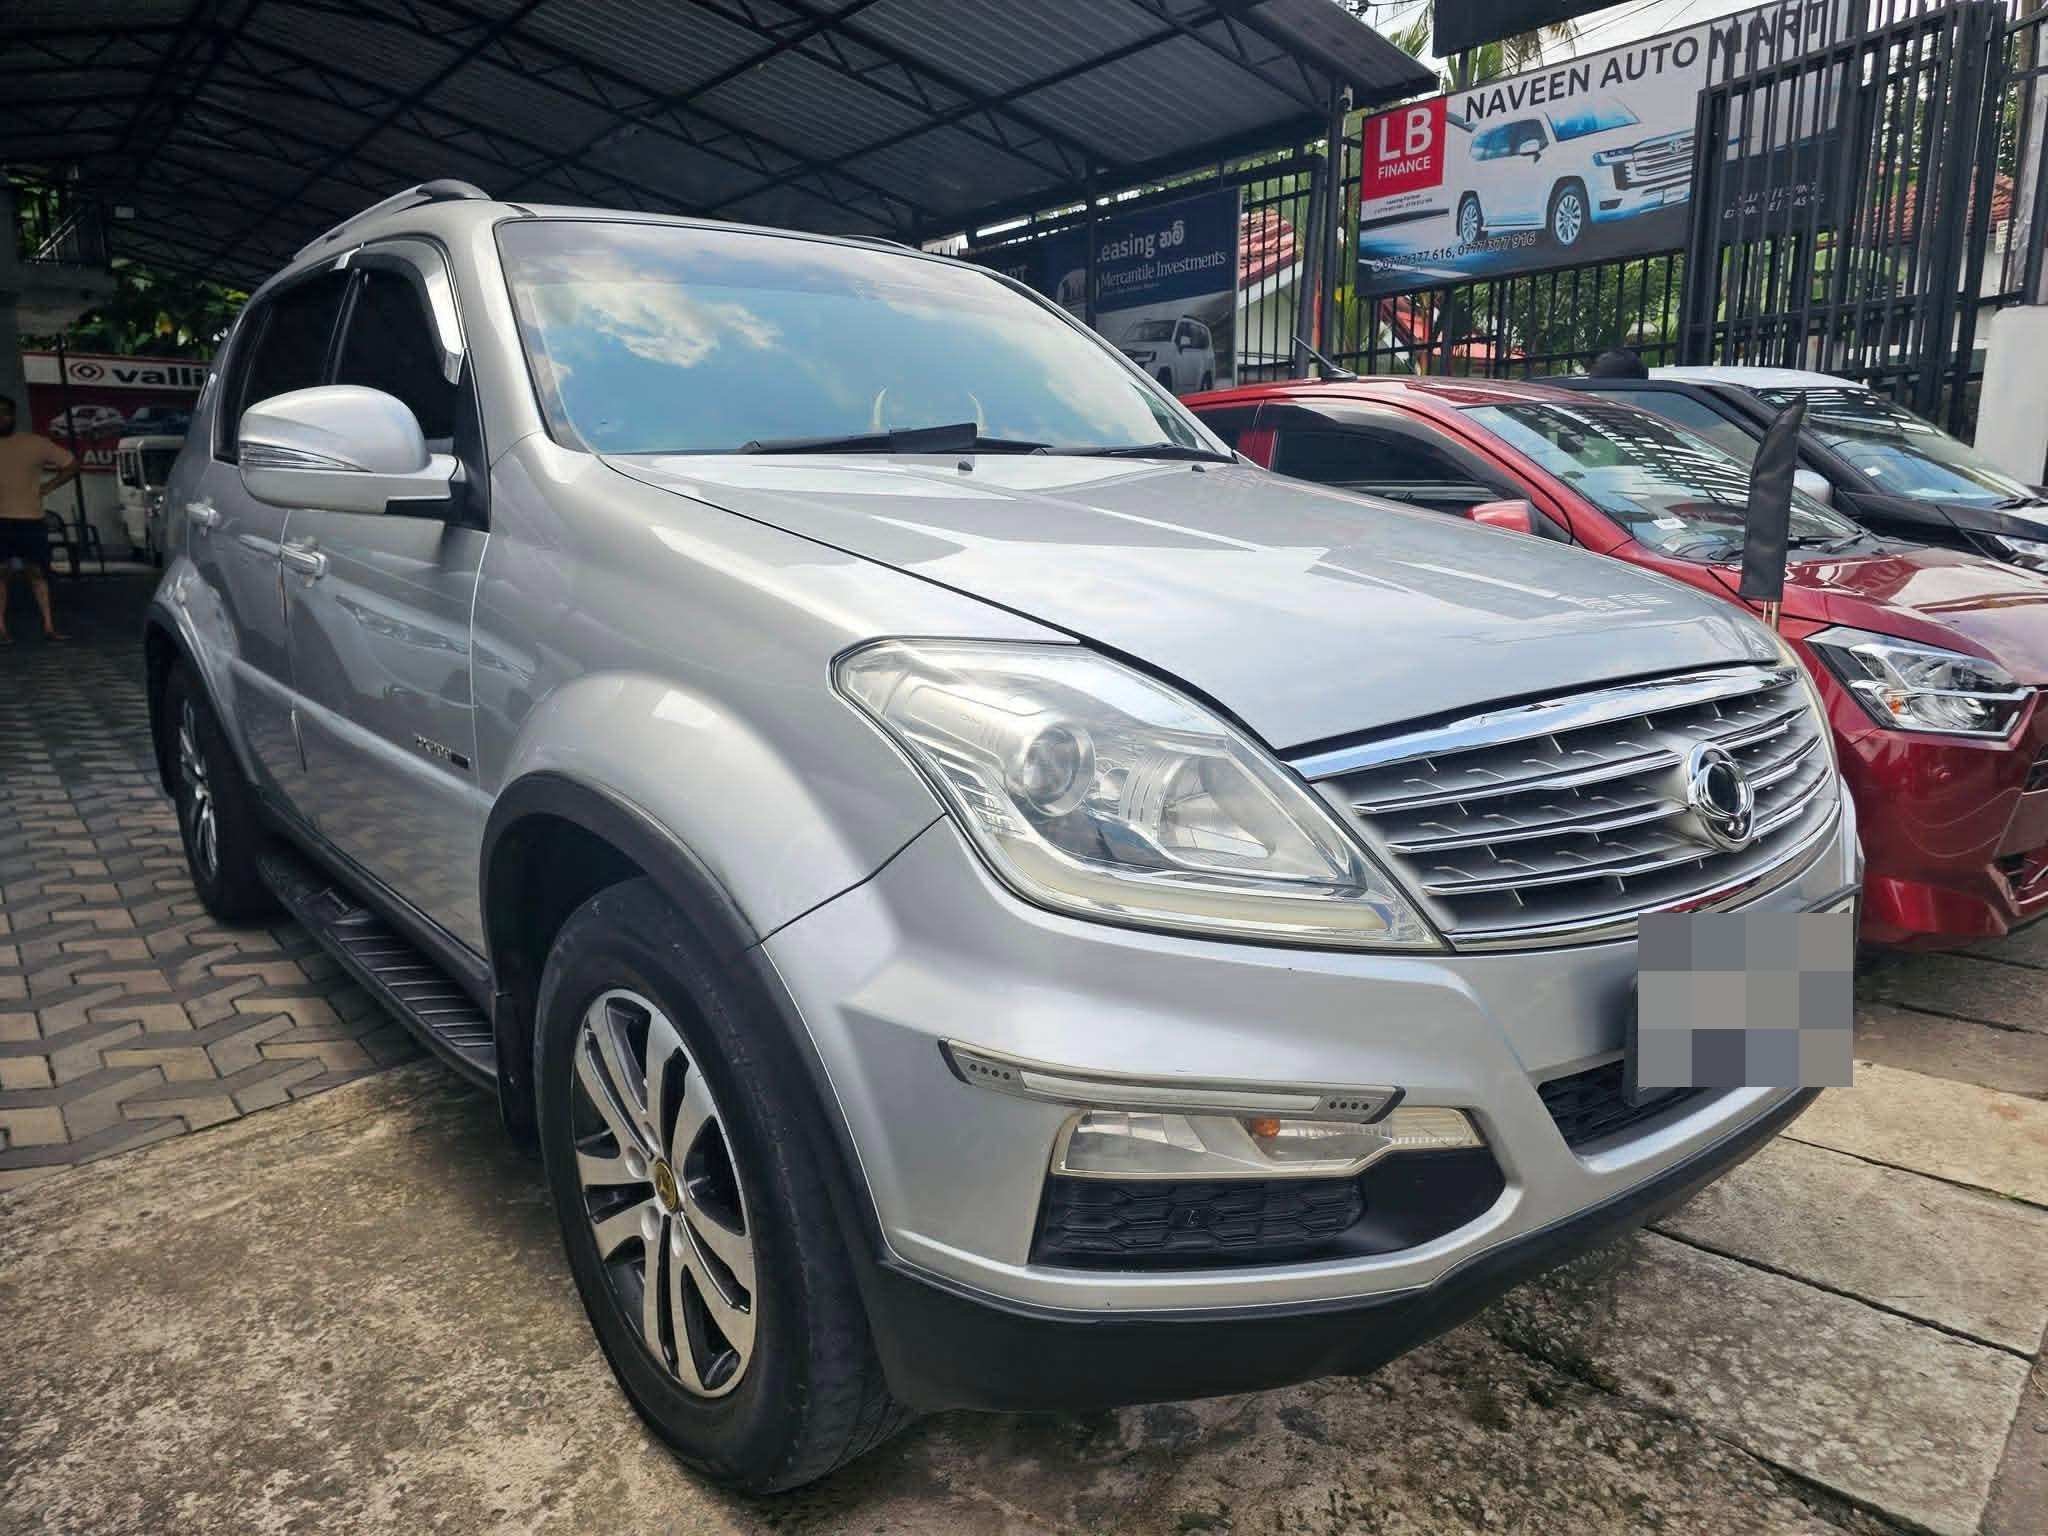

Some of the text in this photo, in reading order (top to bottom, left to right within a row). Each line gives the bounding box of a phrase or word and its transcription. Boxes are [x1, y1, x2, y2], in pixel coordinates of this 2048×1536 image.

[1465, 63, 1591, 122] NAVEEN
[1600, 36, 1699, 88] AUTO
[1379, 108, 1433, 162] LB
[1378, 156, 1431, 180] FINANCE
[1096, 232, 1156, 263] easing
[1101, 251, 1227, 289] Mercantile Investments
[112, 366, 209, 386] valli
